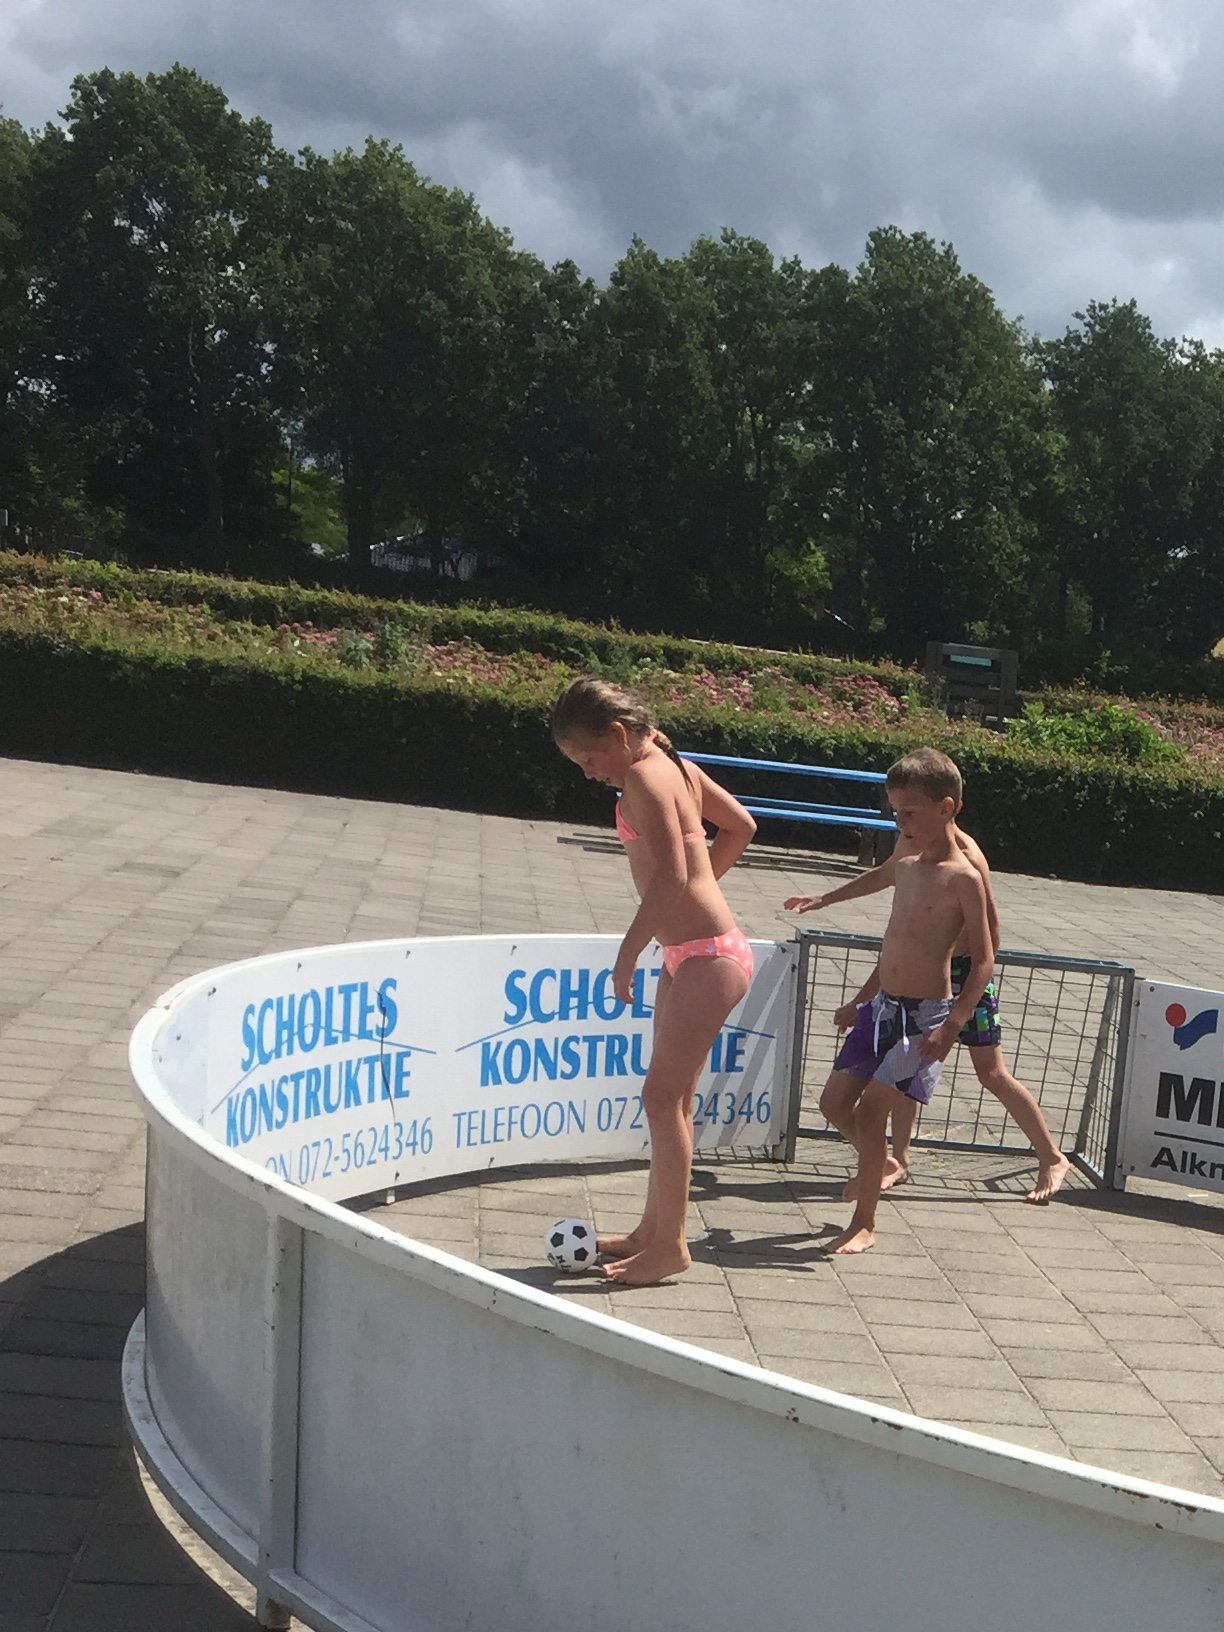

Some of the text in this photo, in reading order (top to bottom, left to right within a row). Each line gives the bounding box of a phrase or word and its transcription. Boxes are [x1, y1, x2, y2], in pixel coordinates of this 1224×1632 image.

[241, 978, 398, 1072] SCHOLTES
[503, 968, 661, 1025] SCHOL
[480, 1032, 747, 1087] KONSTRUIE
[226, 1051, 411, 1148] KONSTRUKTIE
[452, 1090, 772, 1148] TELEFOON 07224346
[299, 1117, 433, 1185] 072-5624346
